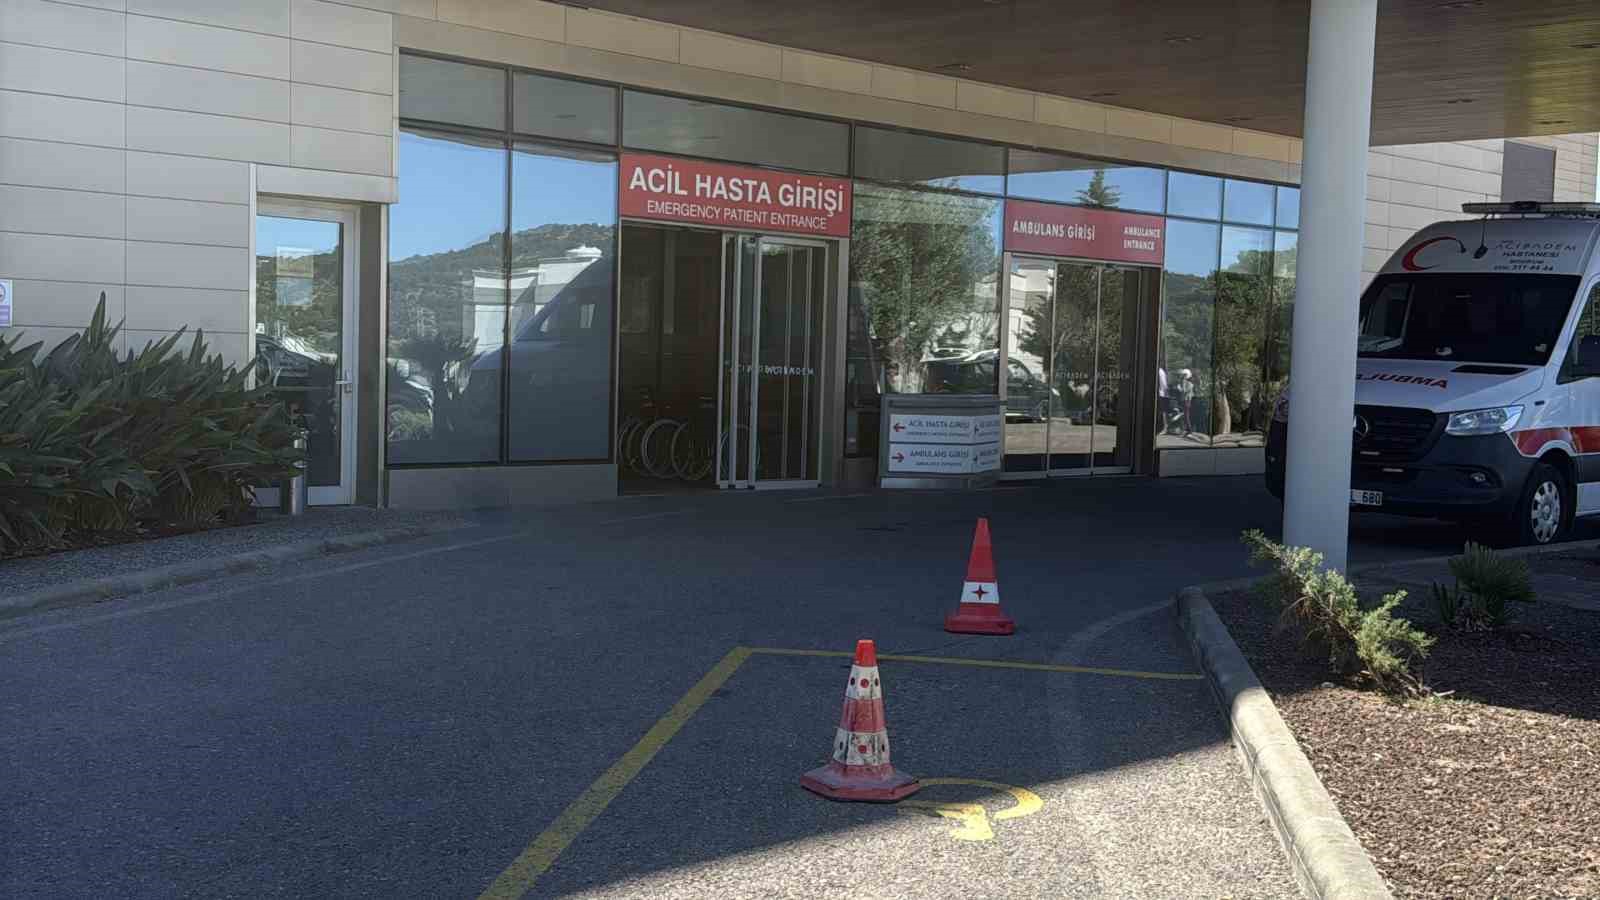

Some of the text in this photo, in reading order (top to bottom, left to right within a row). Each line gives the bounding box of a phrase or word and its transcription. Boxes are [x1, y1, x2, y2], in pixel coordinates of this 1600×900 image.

[629, 164, 844, 217] ACİL HASTA GİRİŞİ
[647, 199, 827, 230] EMERGENCY PATIENT ENTRANCE
[1012, 219, 1065, 238] AMBULANS
[1124, 225, 1161, 239] AMBULANCE
[1123, 239, 1155, 251] ENTRANCE
[1362, 491, 1381, 504] 680
